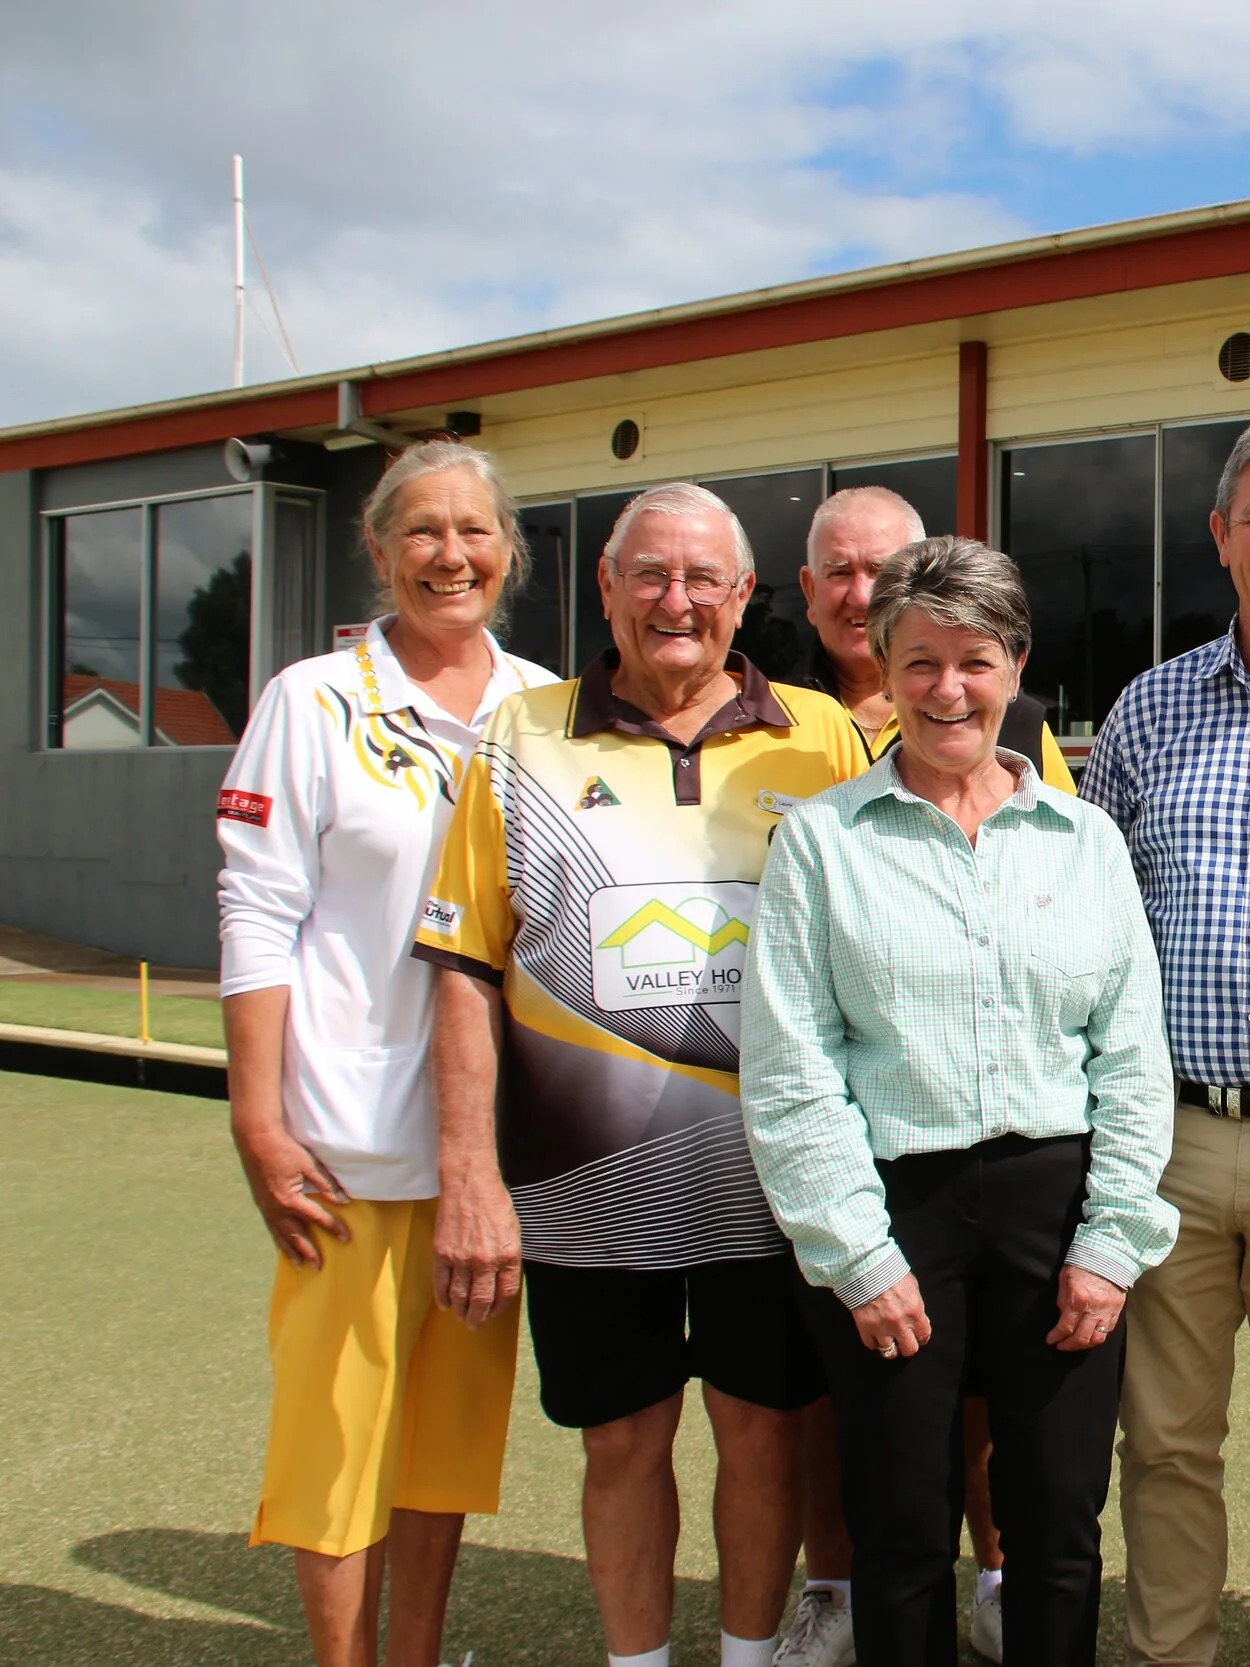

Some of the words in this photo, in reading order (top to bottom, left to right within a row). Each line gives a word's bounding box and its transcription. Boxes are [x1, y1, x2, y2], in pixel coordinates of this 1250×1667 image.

[626, 970, 704, 990] VALLEY
[711, 968, 743, 985] HO
[676, 987, 709, 996] Since
[713, 984, 736, 993] 1971
